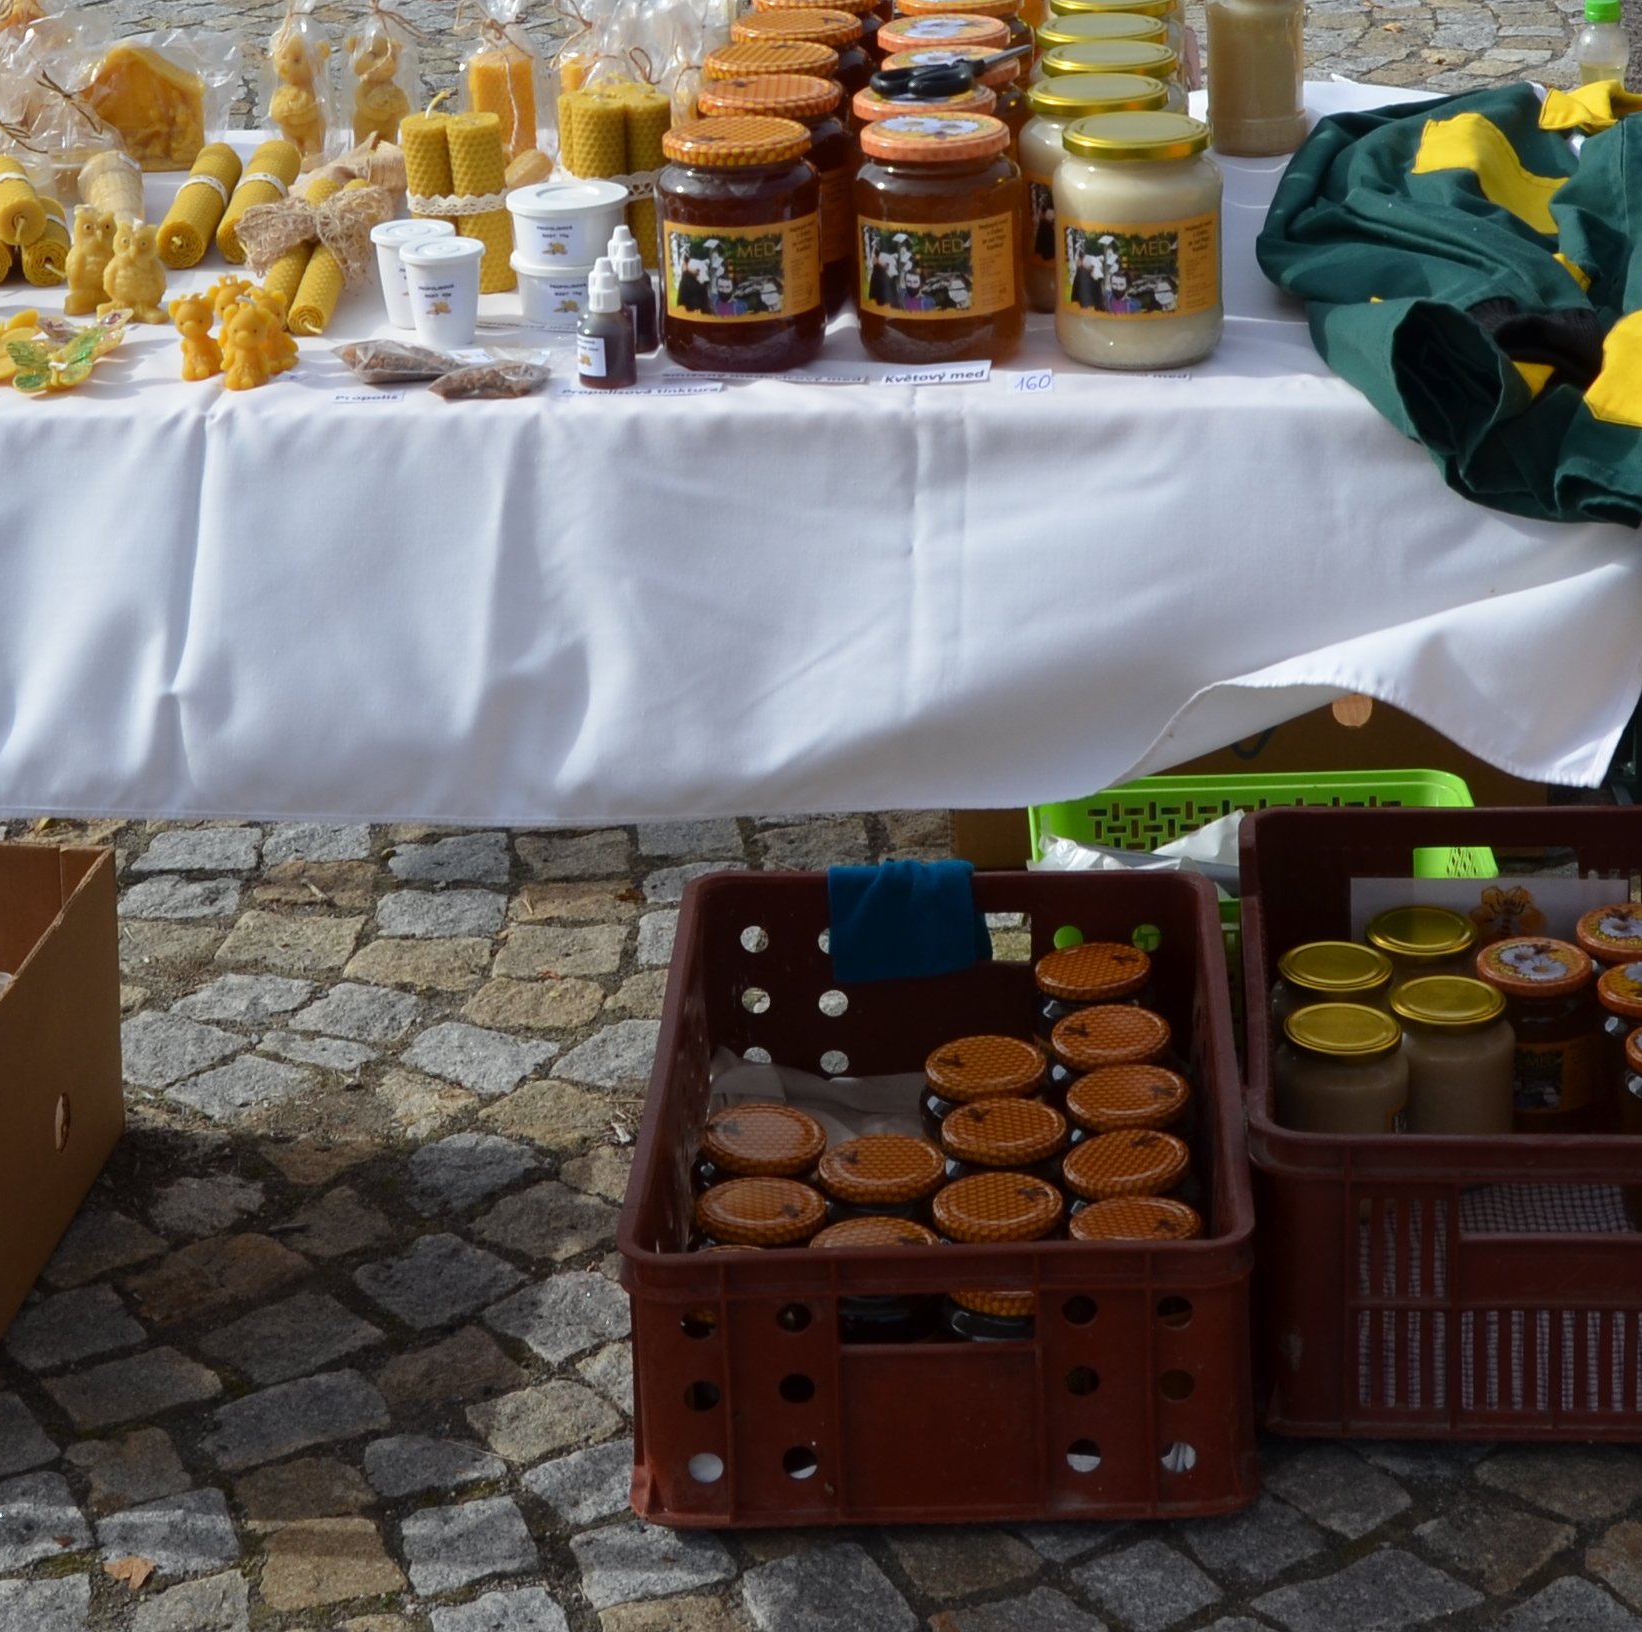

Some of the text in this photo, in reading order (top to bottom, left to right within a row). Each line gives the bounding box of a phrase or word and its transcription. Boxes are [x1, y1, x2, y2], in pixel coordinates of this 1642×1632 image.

[737, 242, 778, 260] MED
[924, 238, 965, 255] MED
[1131, 240, 1172, 257] MED
[884, 369, 985, 384] Květový med
[1014, 374, 1051, 391] 160
